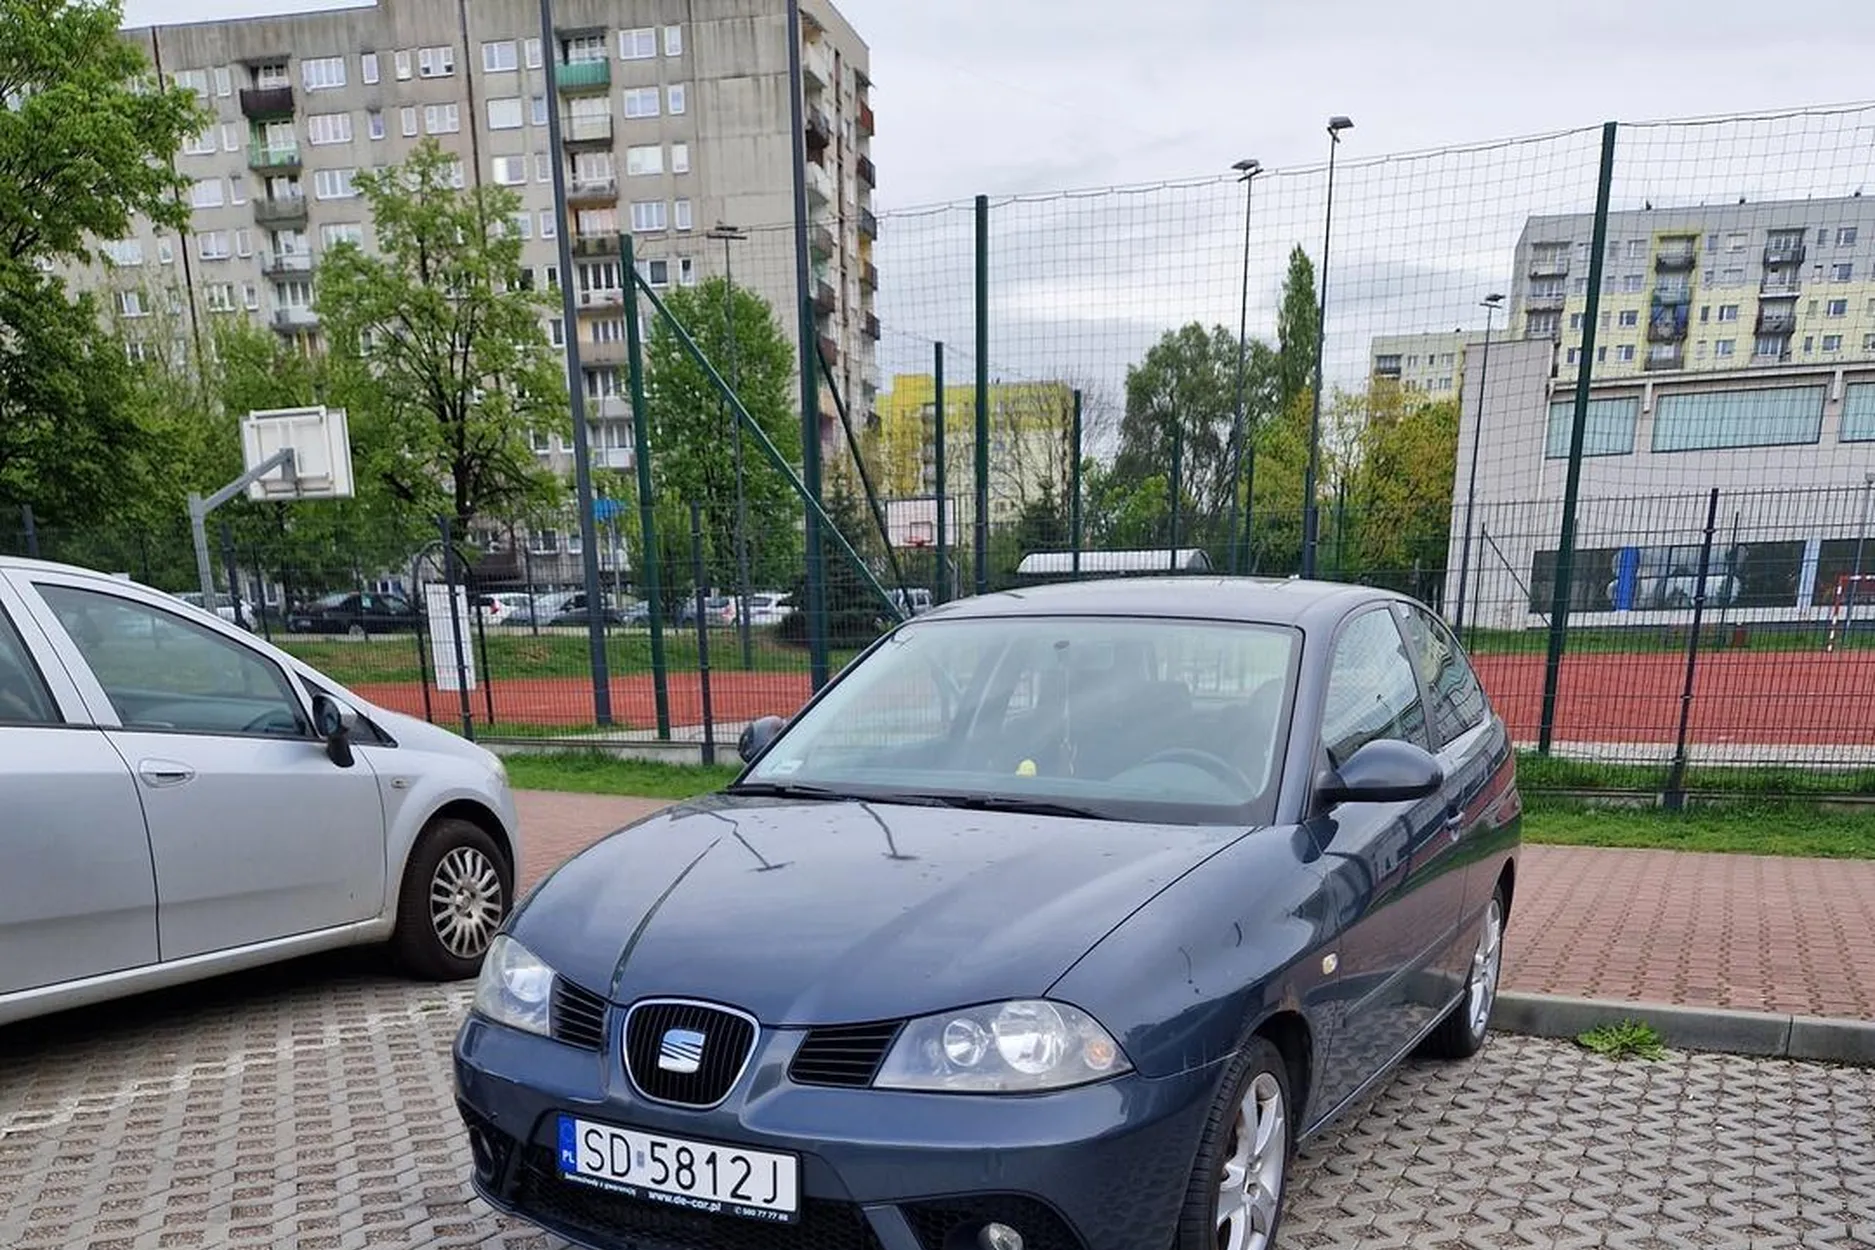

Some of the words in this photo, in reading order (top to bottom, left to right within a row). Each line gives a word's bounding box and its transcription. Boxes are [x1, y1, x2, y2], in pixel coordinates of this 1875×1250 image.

[562, 1151, 575, 1164] PL
[584, 1128, 631, 1178] SD
[650, 1141, 777, 1204] 5812J
